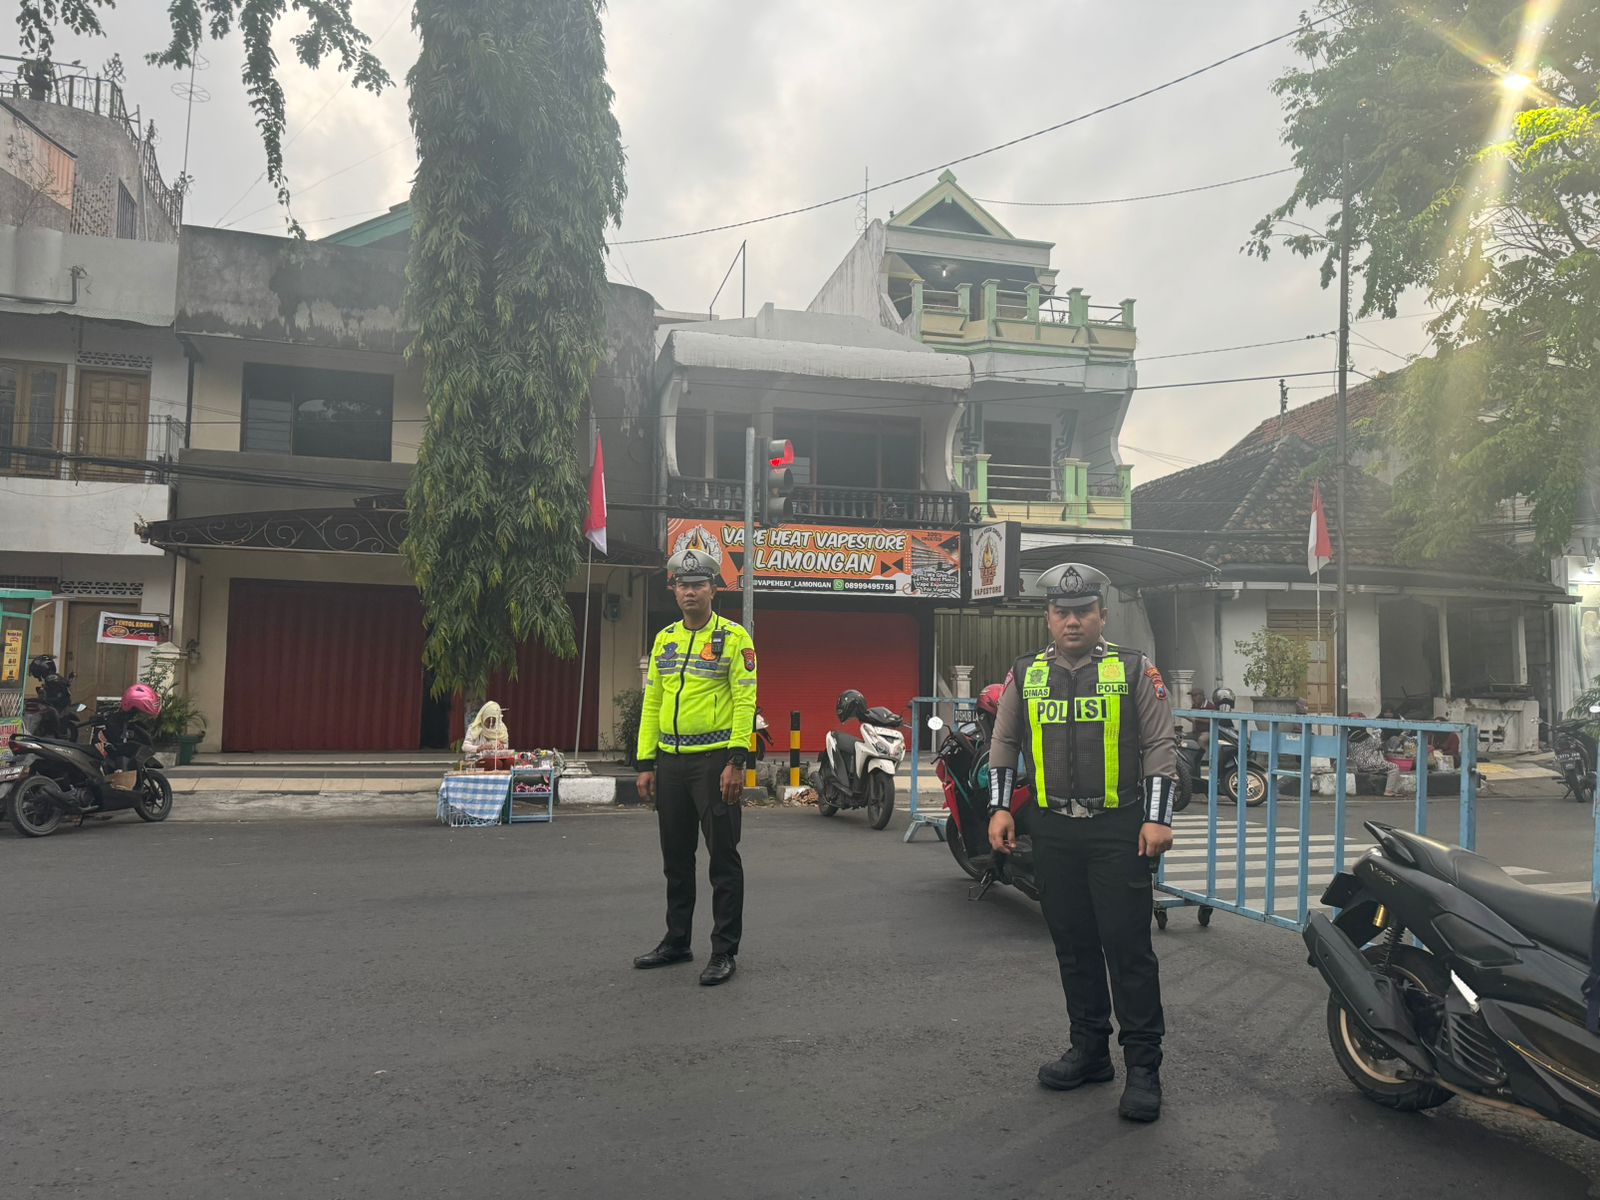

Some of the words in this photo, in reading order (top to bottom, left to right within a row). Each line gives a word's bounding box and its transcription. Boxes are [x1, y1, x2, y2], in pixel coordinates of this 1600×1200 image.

[770, 529, 813, 548] HEAT
[816, 531, 907, 551] VAPESTORE
[755, 550, 876, 574] LAMONGAN
[845, 582, 895, 591] 08999495758
[1024, 688, 1049, 698] DIMAS
[1098, 684, 1127, 693] POLRI
